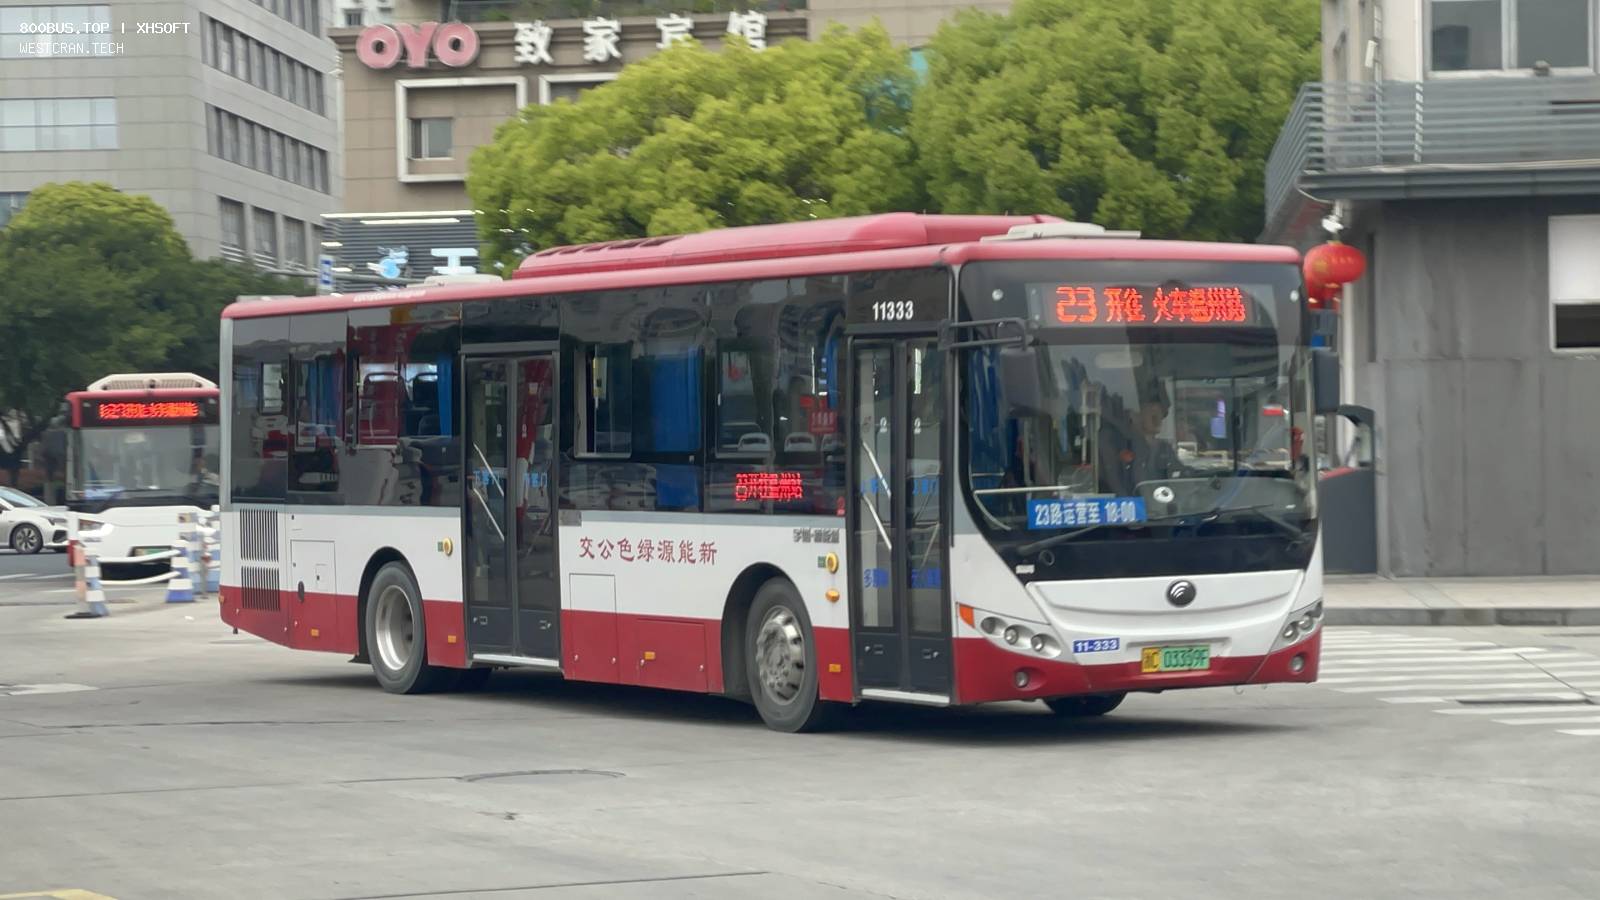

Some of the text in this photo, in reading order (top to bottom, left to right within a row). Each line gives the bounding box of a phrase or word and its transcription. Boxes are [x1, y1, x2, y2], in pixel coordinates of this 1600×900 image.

[356, 22, 480, 69] OYO
[872, 300, 914, 321] 11333
[1056, 286, 1097, 322] 23
[1075, 639, 1118, 652] 11-333
